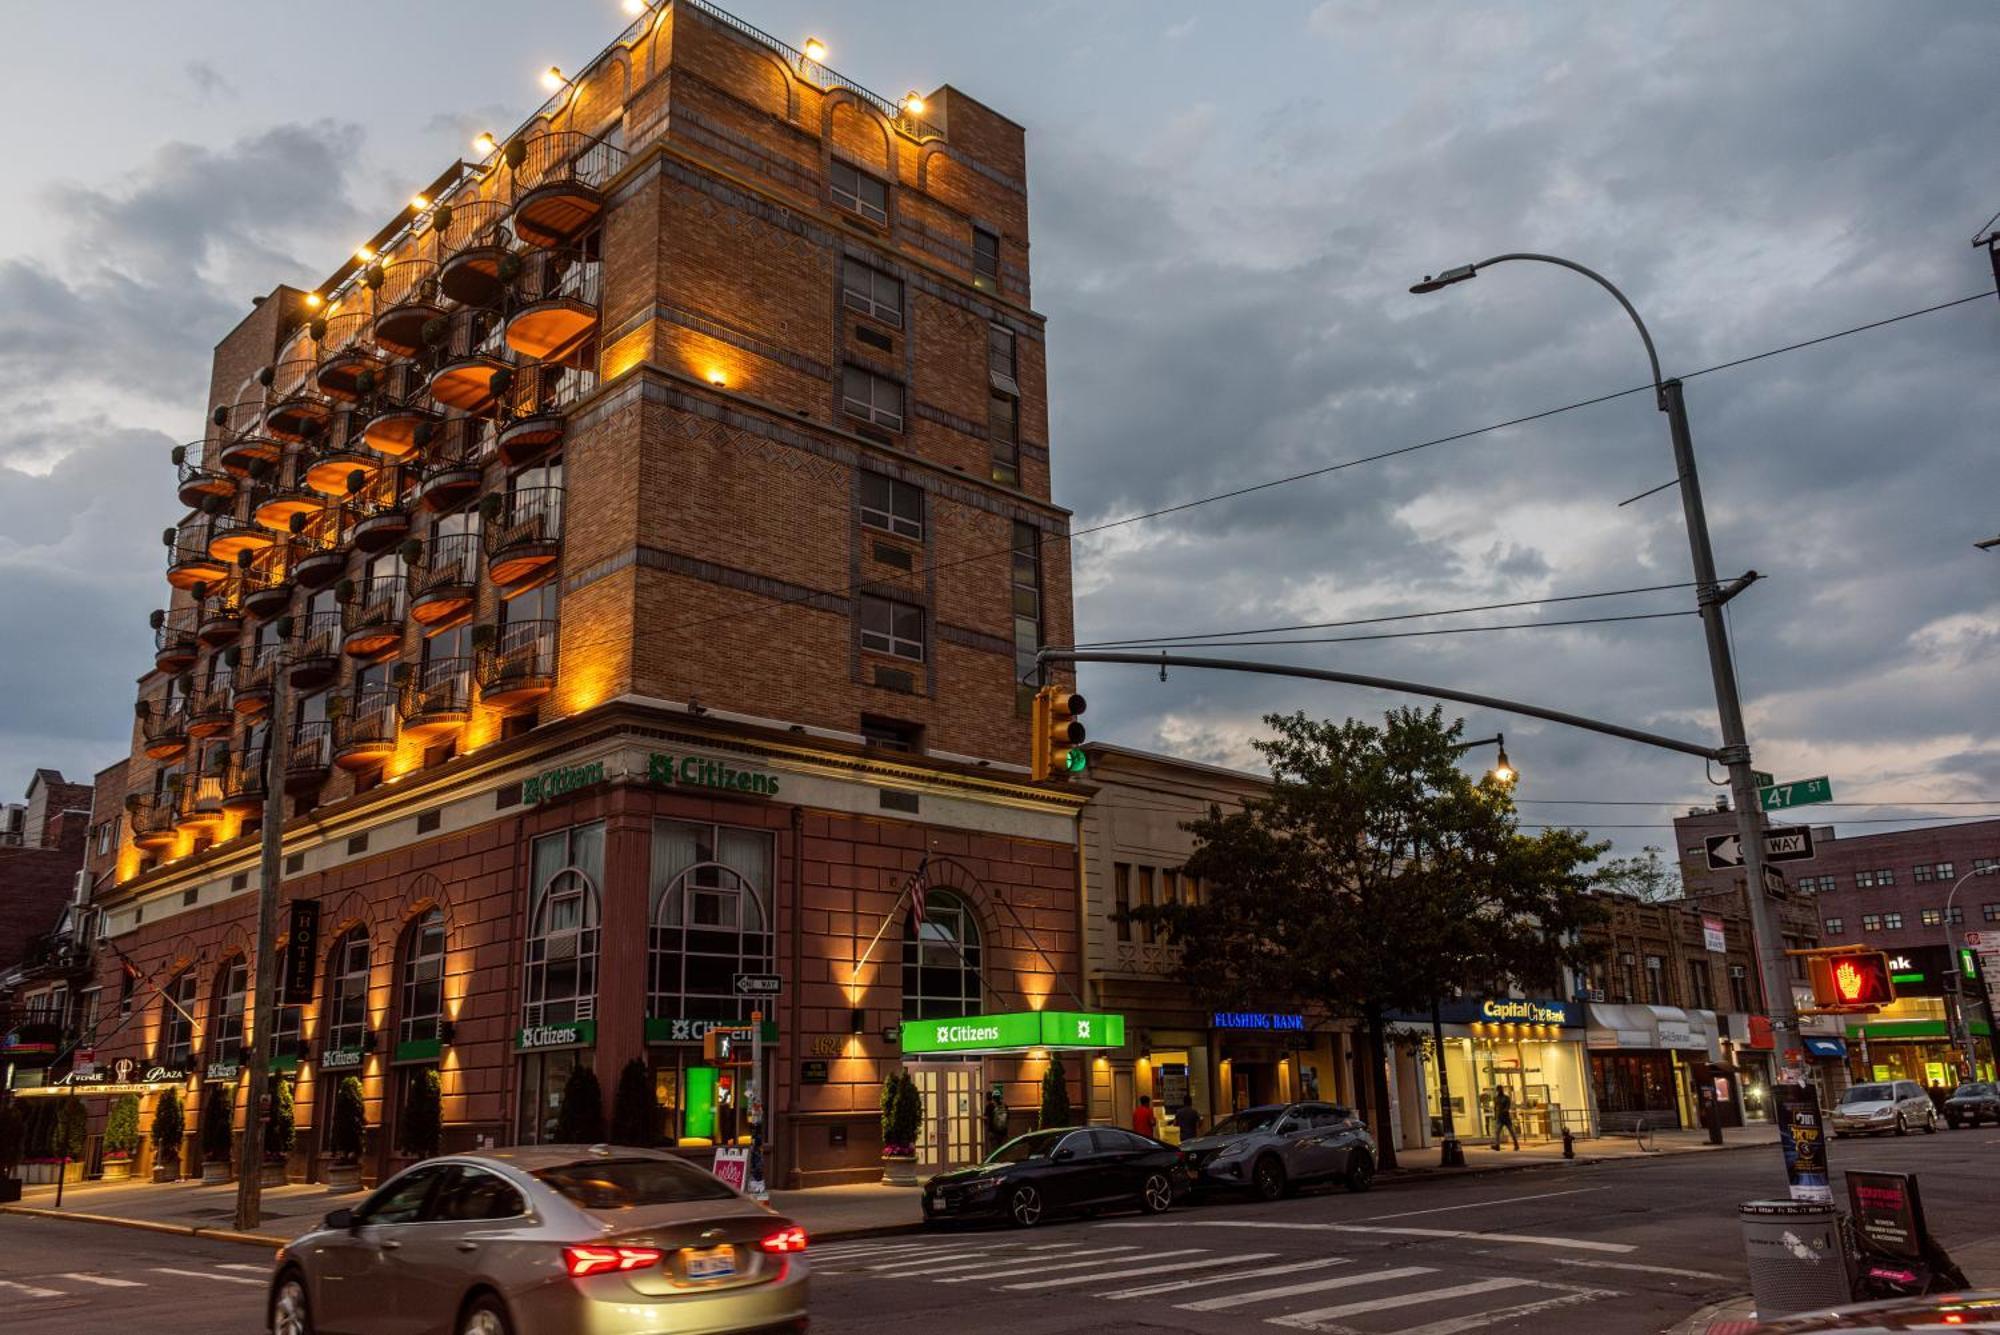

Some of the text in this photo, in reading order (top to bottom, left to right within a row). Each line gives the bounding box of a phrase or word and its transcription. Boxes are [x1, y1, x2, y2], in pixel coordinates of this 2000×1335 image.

[680, 757, 780, 795] Citizens
[1767, 781, 1821, 808] 47 ST
[1769, 836, 1800, 851] WAY
[297, 914, 311, 989] HOTEL
[1215, 1012, 1304, 1031] FLUSHING BANK
[1483, 1000, 1527, 1020] Capital
[1546, 1009, 1566, 1023] Bank
[533, 1026, 577, 1046] Citizens
[949, 1026, 999, 1042] Citizens
